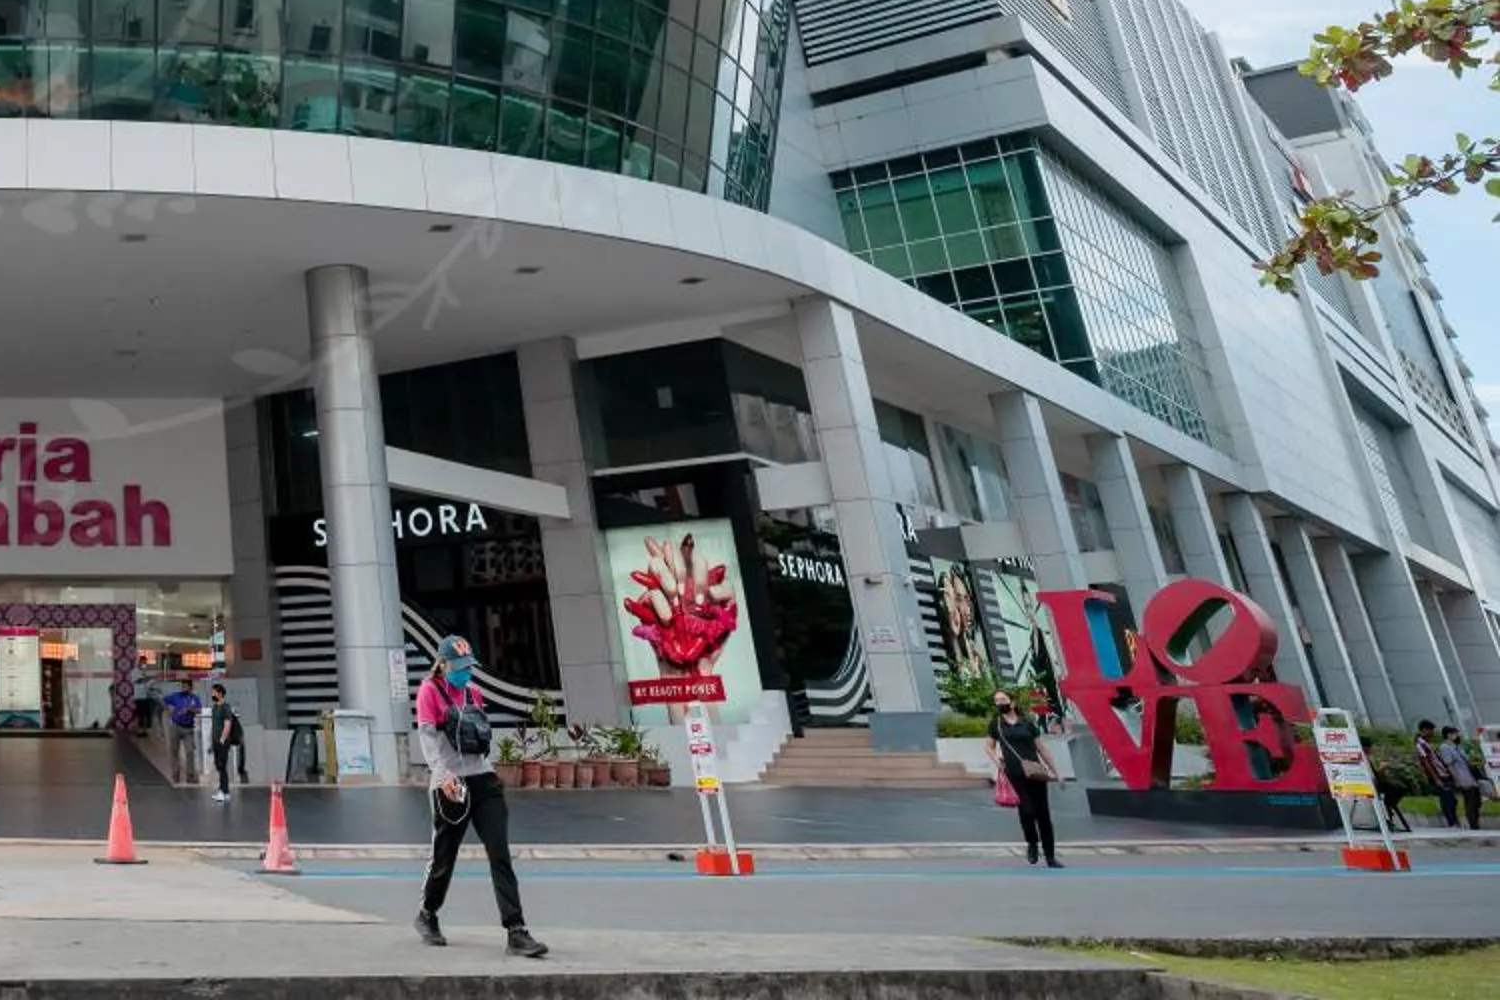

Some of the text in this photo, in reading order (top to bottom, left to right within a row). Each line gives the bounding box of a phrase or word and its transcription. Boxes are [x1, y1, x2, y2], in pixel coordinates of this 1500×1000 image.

[778, 553, 846, 587] SEPHORA
[649, 685, 682, 697] BEAUTY
[684, 683, 717, 695] POWER
